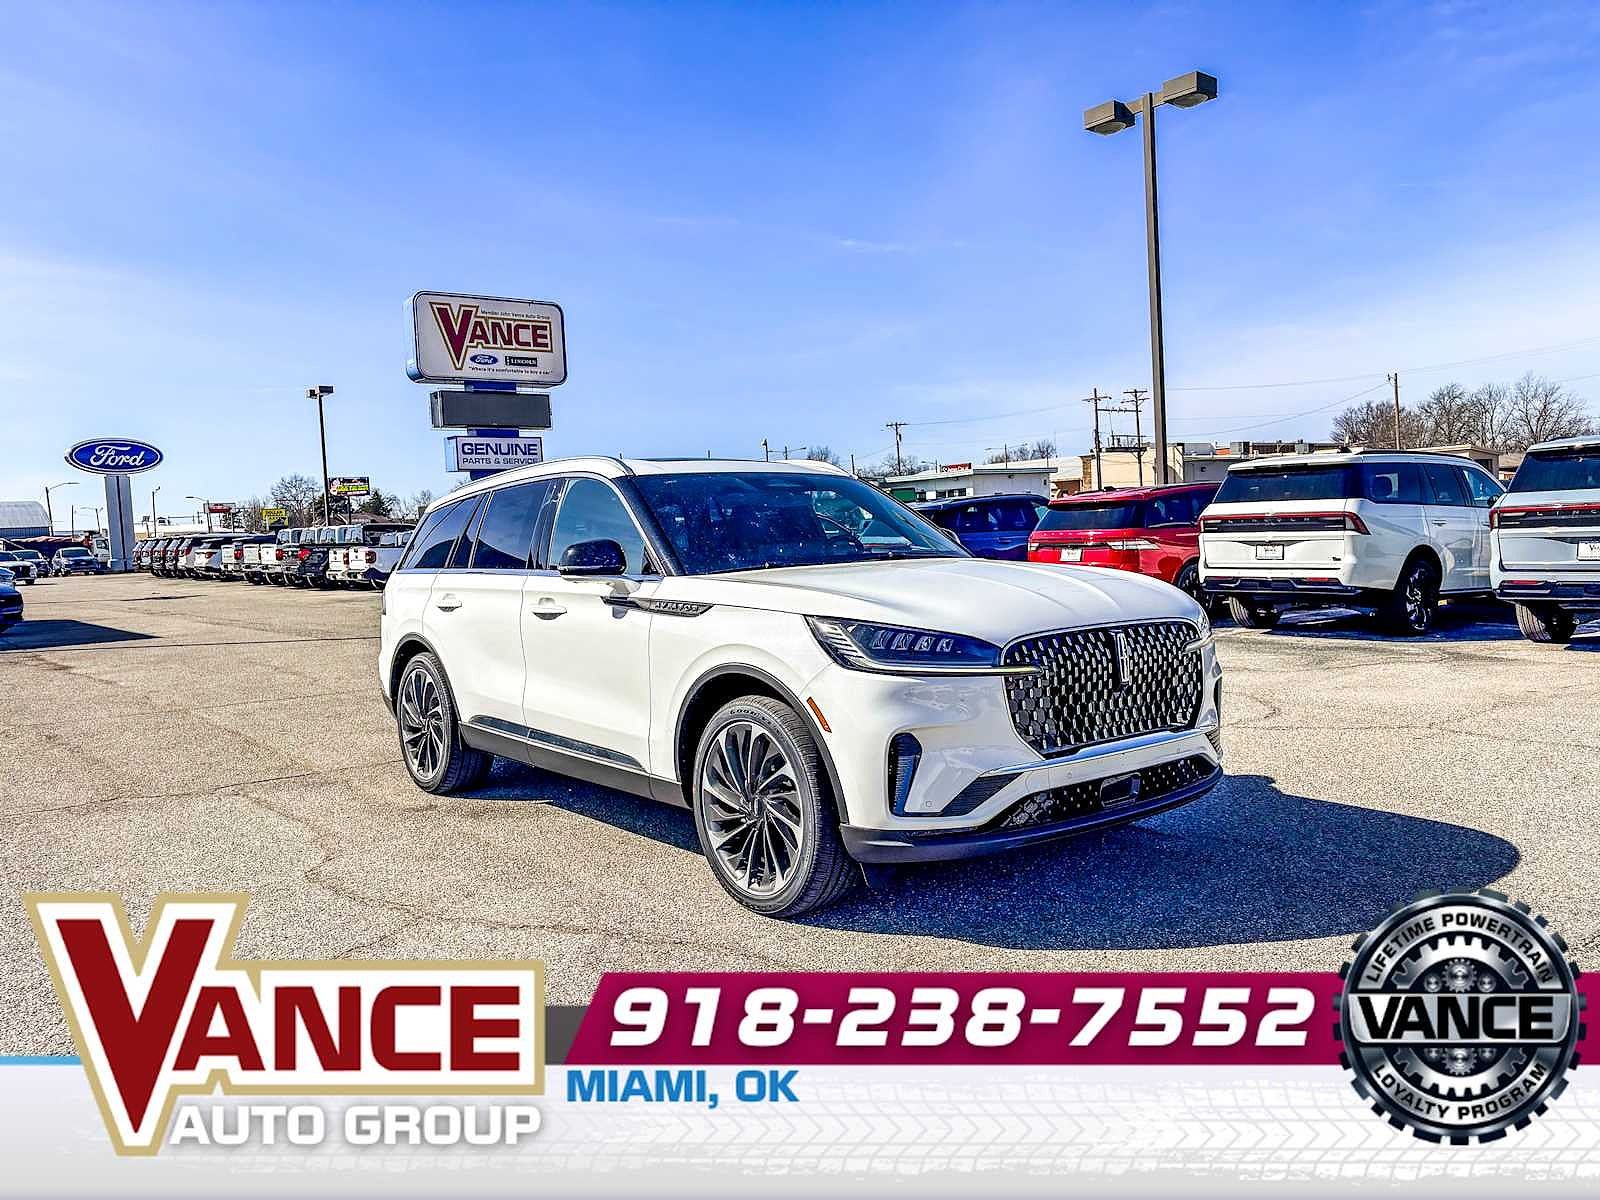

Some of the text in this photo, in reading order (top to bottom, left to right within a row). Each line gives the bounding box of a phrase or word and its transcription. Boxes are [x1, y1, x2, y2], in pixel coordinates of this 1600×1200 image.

[475, 354, 494, 364] Ford
[90, 444, 145, 466] Ford
[461, 442, 538, 456] GENUINE
[462, 457, 539, 465] PARTS & SERVICE
